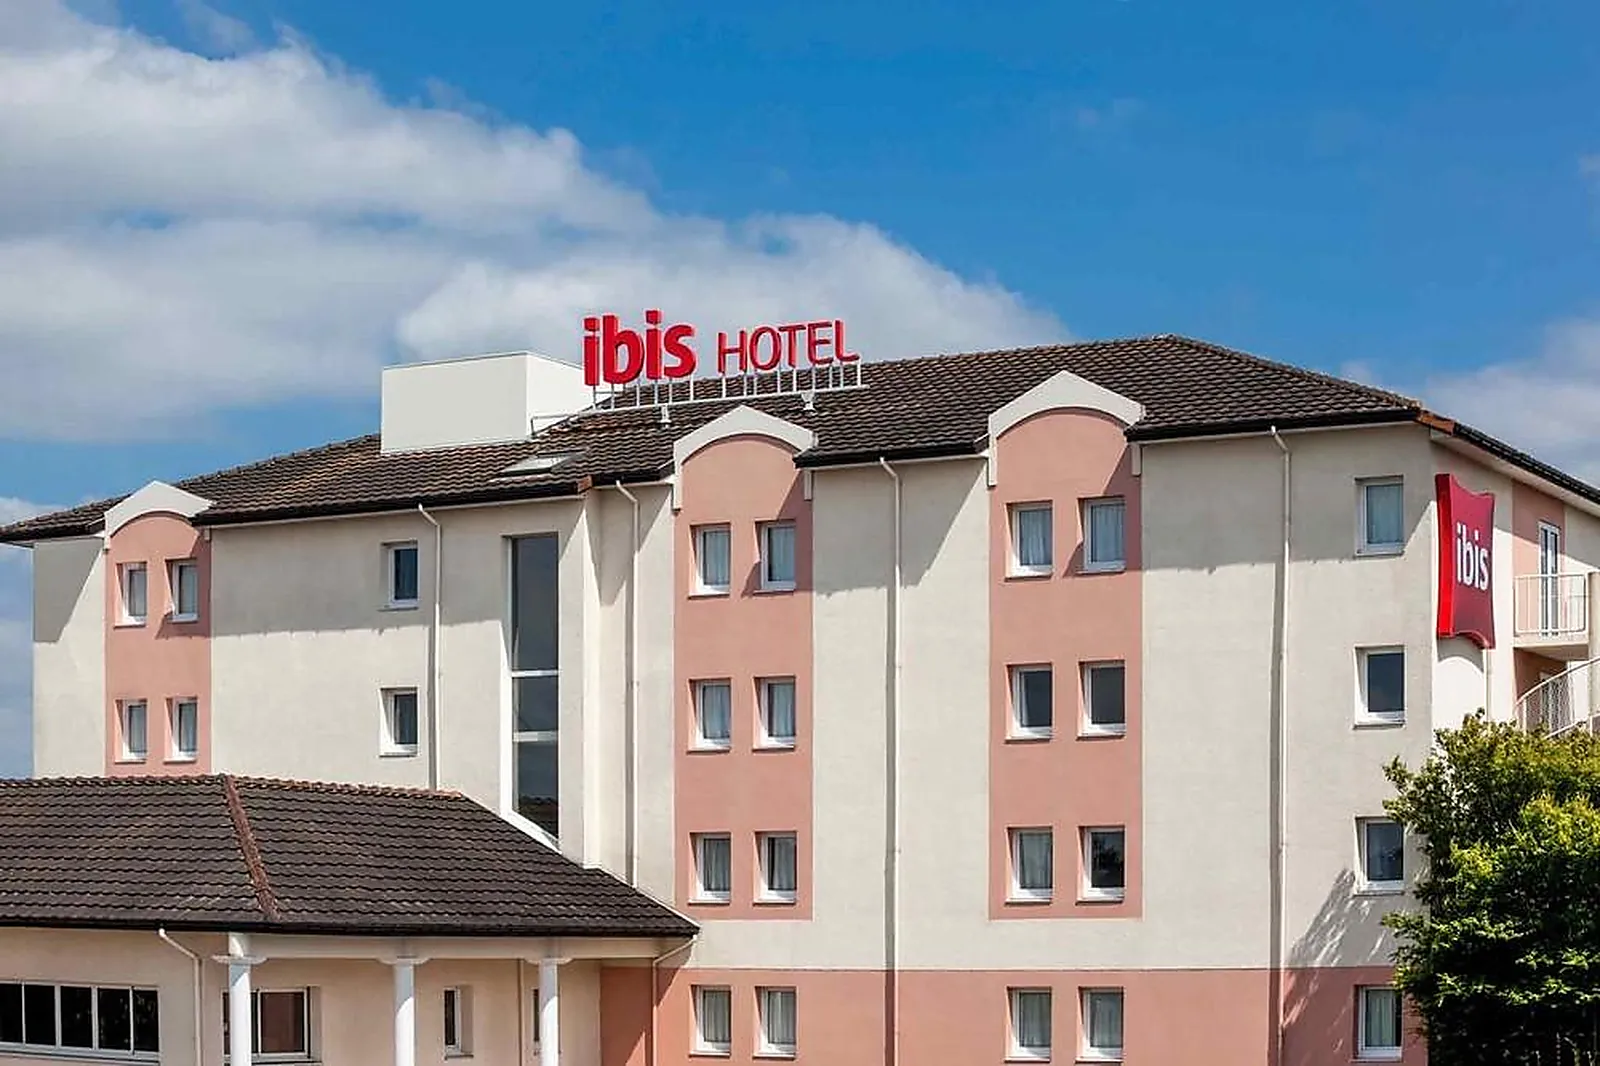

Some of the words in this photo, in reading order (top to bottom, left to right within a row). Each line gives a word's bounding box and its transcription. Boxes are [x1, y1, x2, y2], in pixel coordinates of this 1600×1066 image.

[583, 309, 697, 386] ibis
[717, 319, 860, 374] HOTEL
[1456, 521, 1490, 591] ibis
